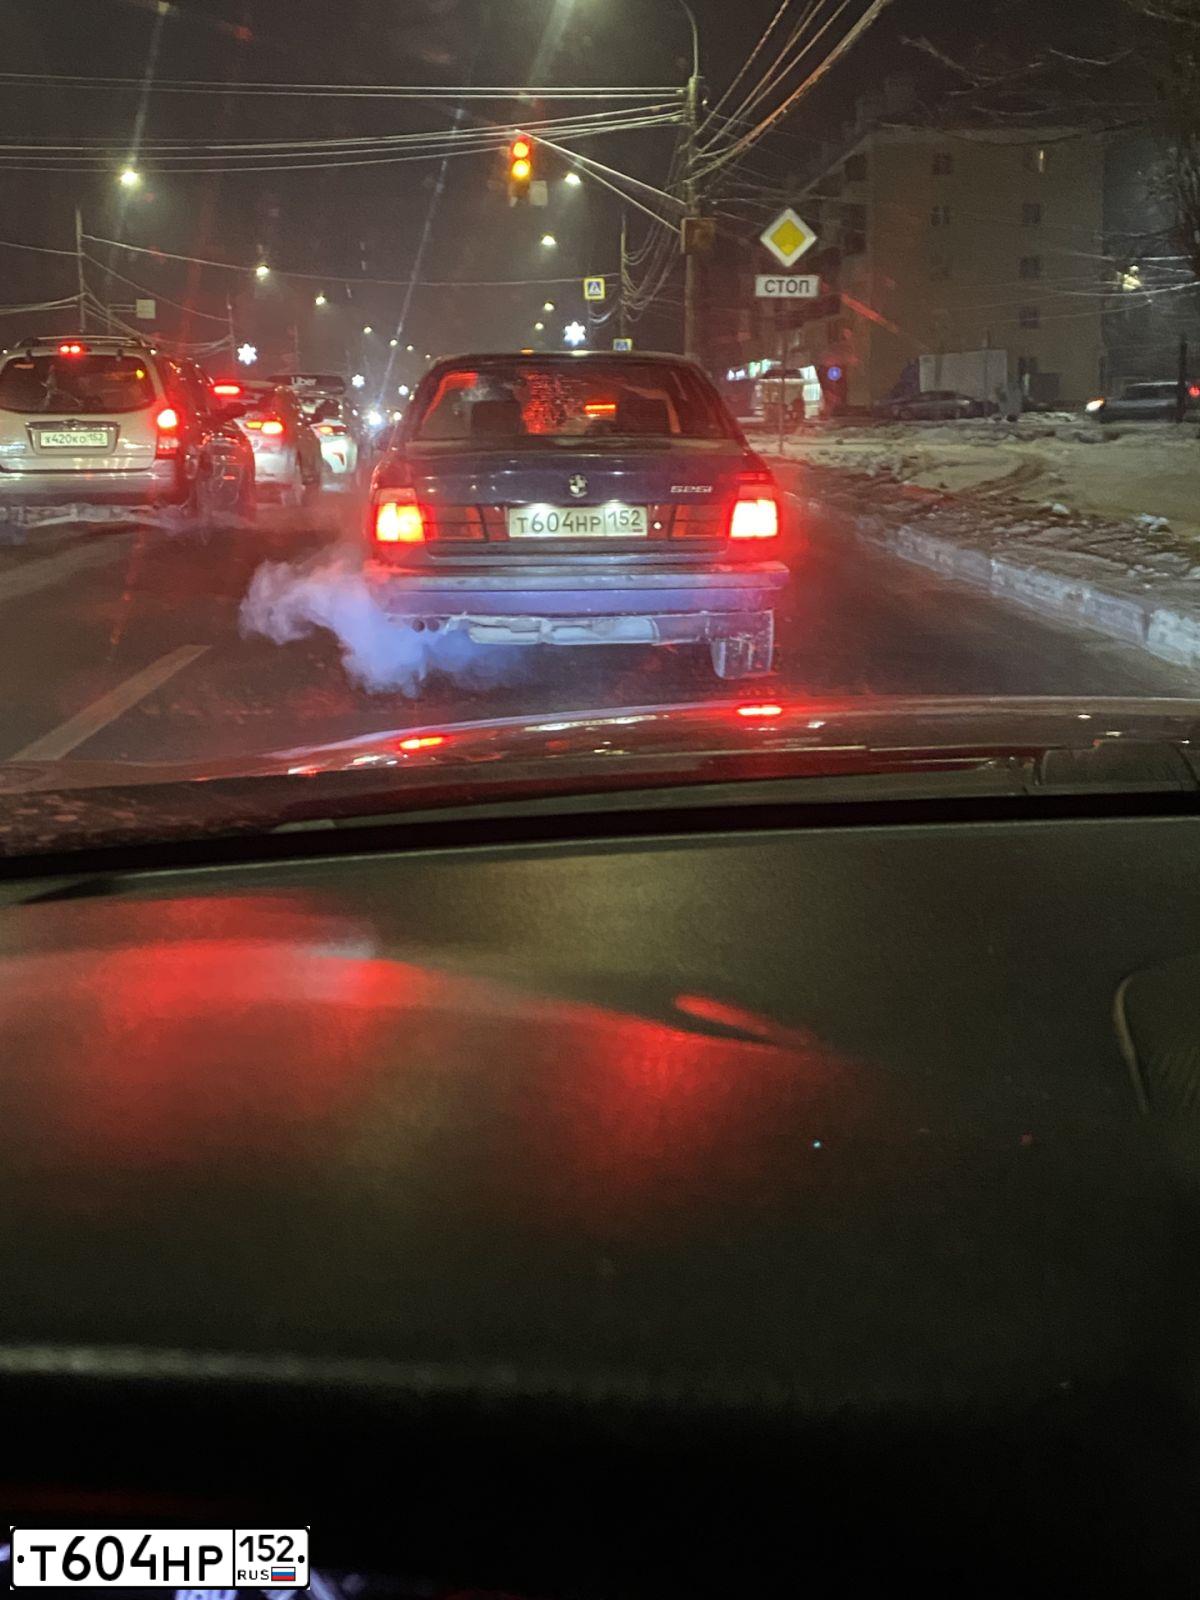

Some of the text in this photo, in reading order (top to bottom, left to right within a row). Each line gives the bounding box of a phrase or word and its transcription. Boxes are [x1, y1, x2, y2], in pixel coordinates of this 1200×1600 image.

[765, 279, 810, 293] СТОП
[291, 376, 318, 386] Uber
[516, 510, 641, 533] Т604НР 152
